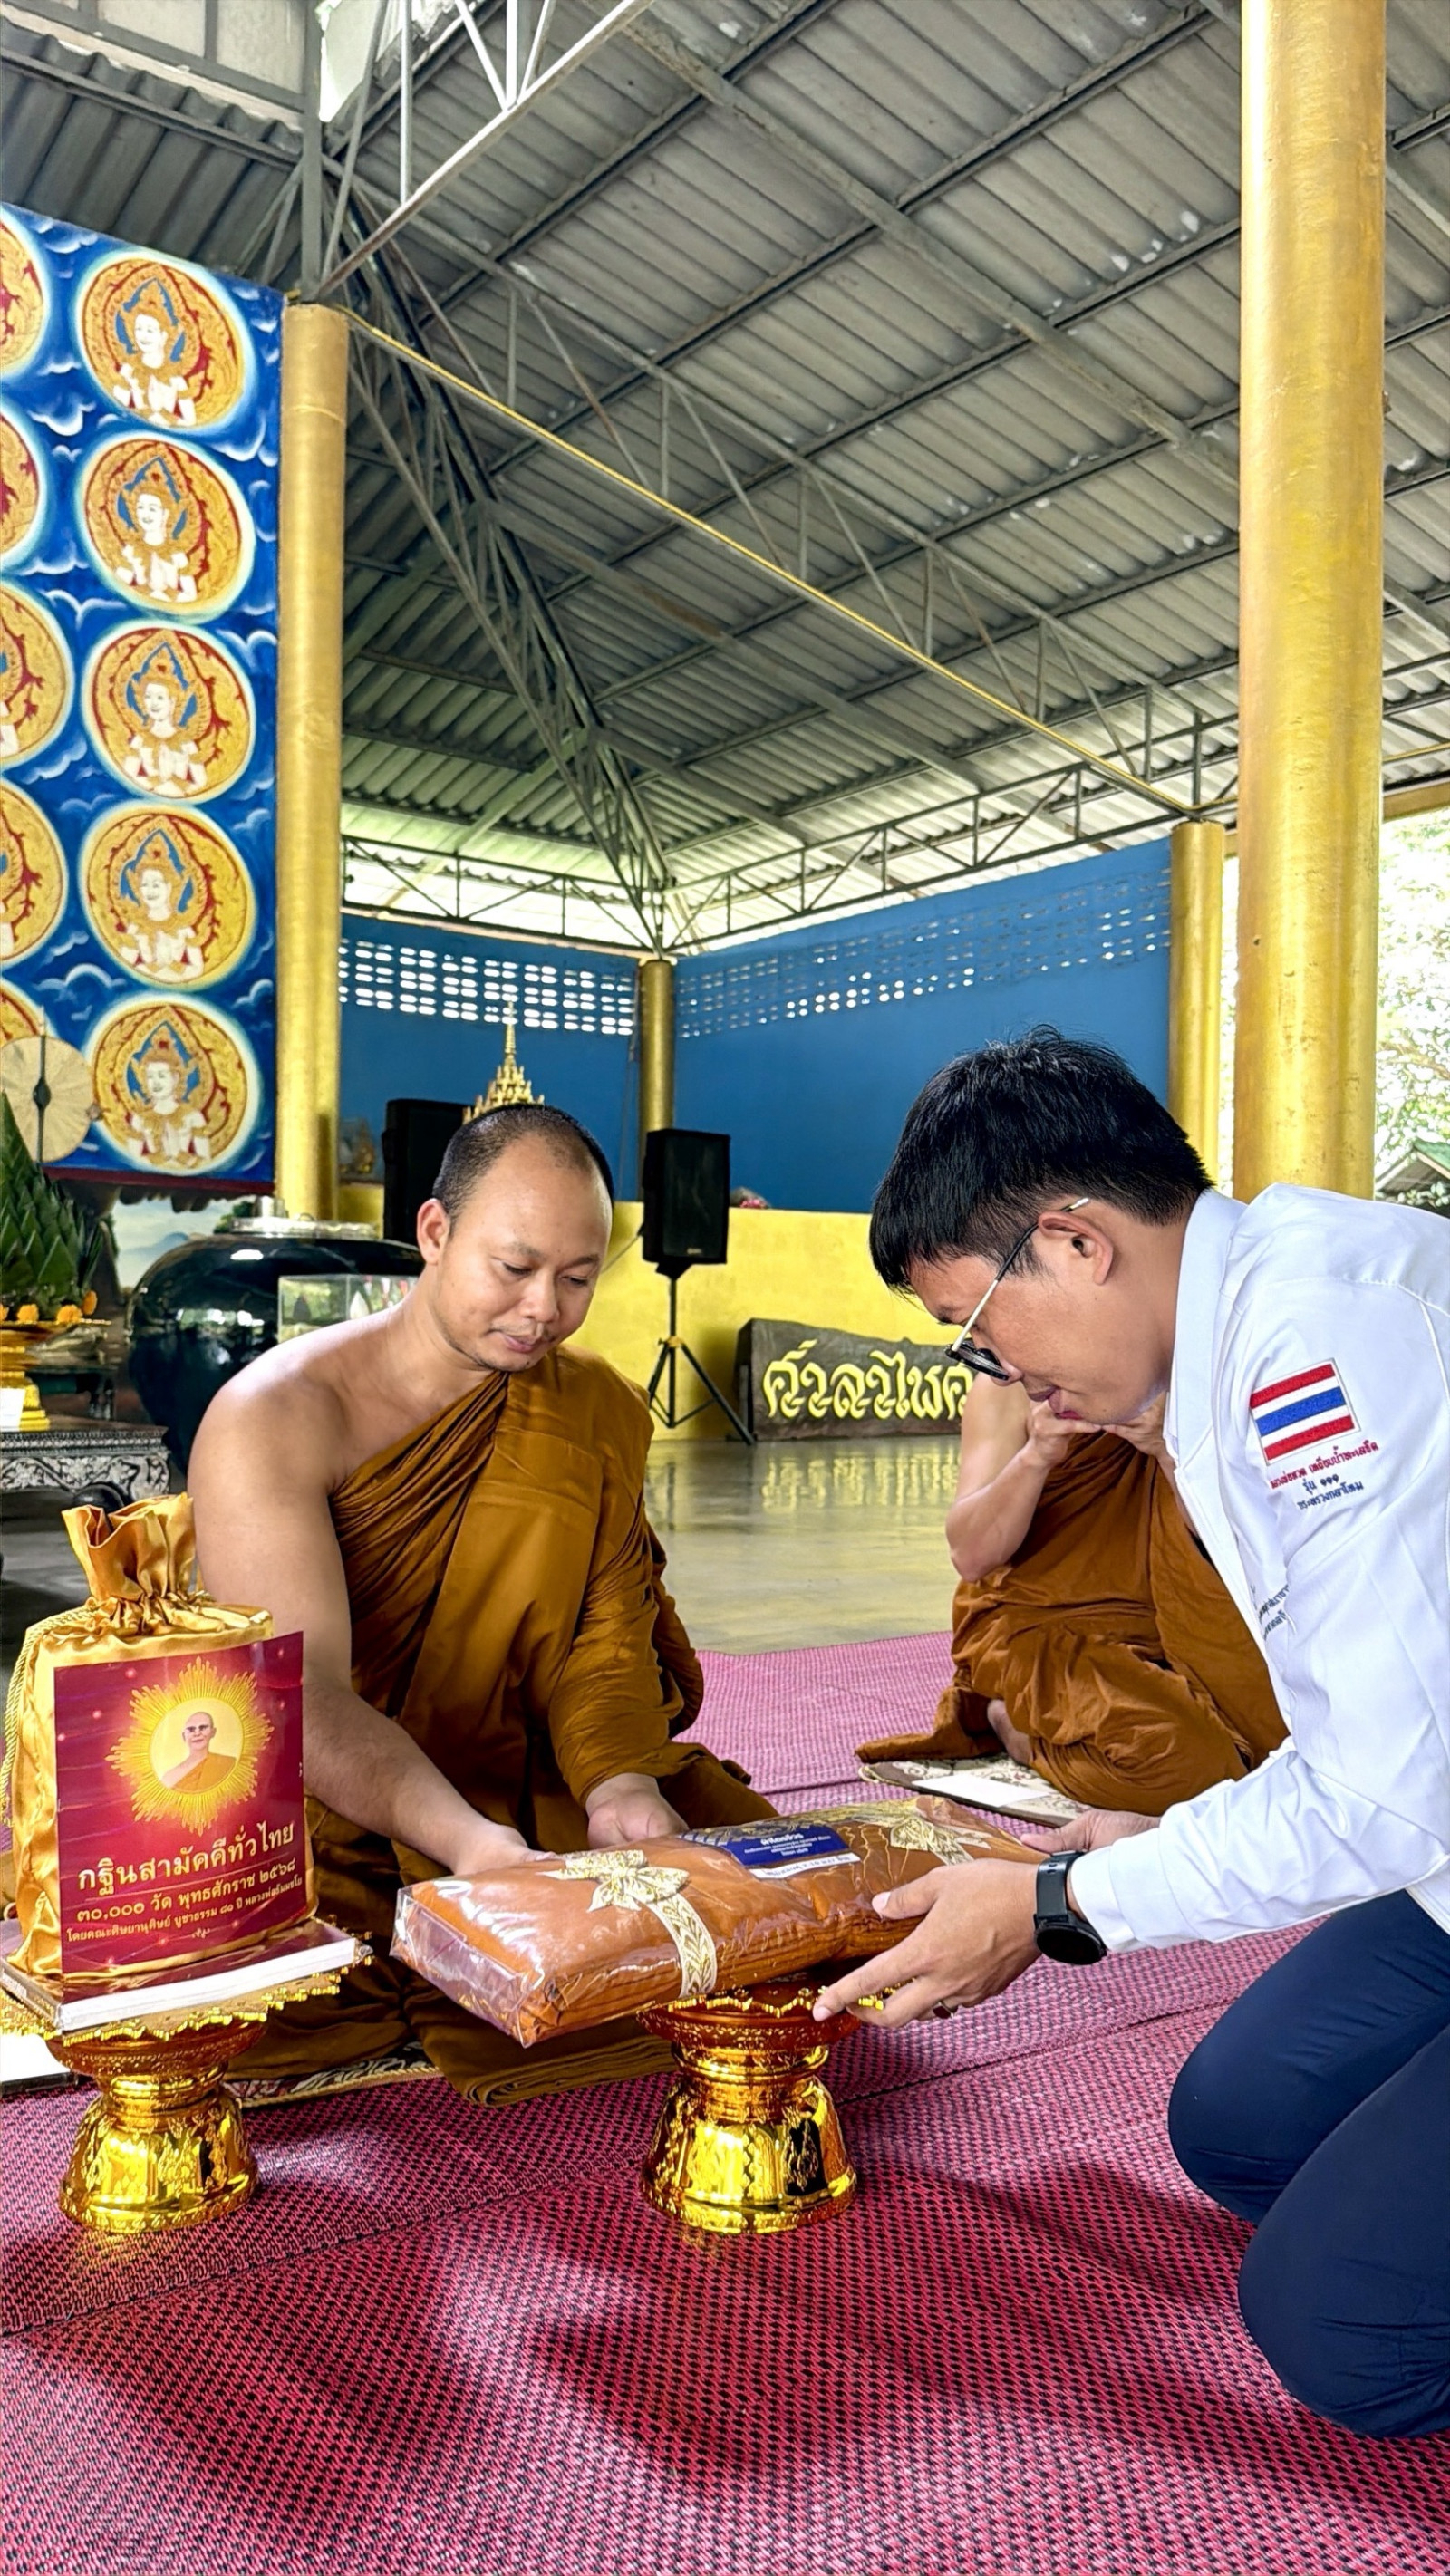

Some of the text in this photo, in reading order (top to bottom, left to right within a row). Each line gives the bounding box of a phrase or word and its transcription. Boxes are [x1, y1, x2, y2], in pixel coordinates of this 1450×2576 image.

[78, 1819, 295, 1896] กฐินสามัคคีทั่วไทย
[150, 1891, 172, 1911] วัด
[178, 1872, 256, 1910] พุทธศักราช
[259, 1857, 296, 1884] ๒๕๖๘
[66, 1914, 171, 1943] โดยคณะศิษยานุศิษย์
[174, 1906, 218, 1929] บูชาธรรม
[236, 1896, 243, 1909] ปี
[245, 1873, 303, 1907] หลวงพ่อธัมมชโย
